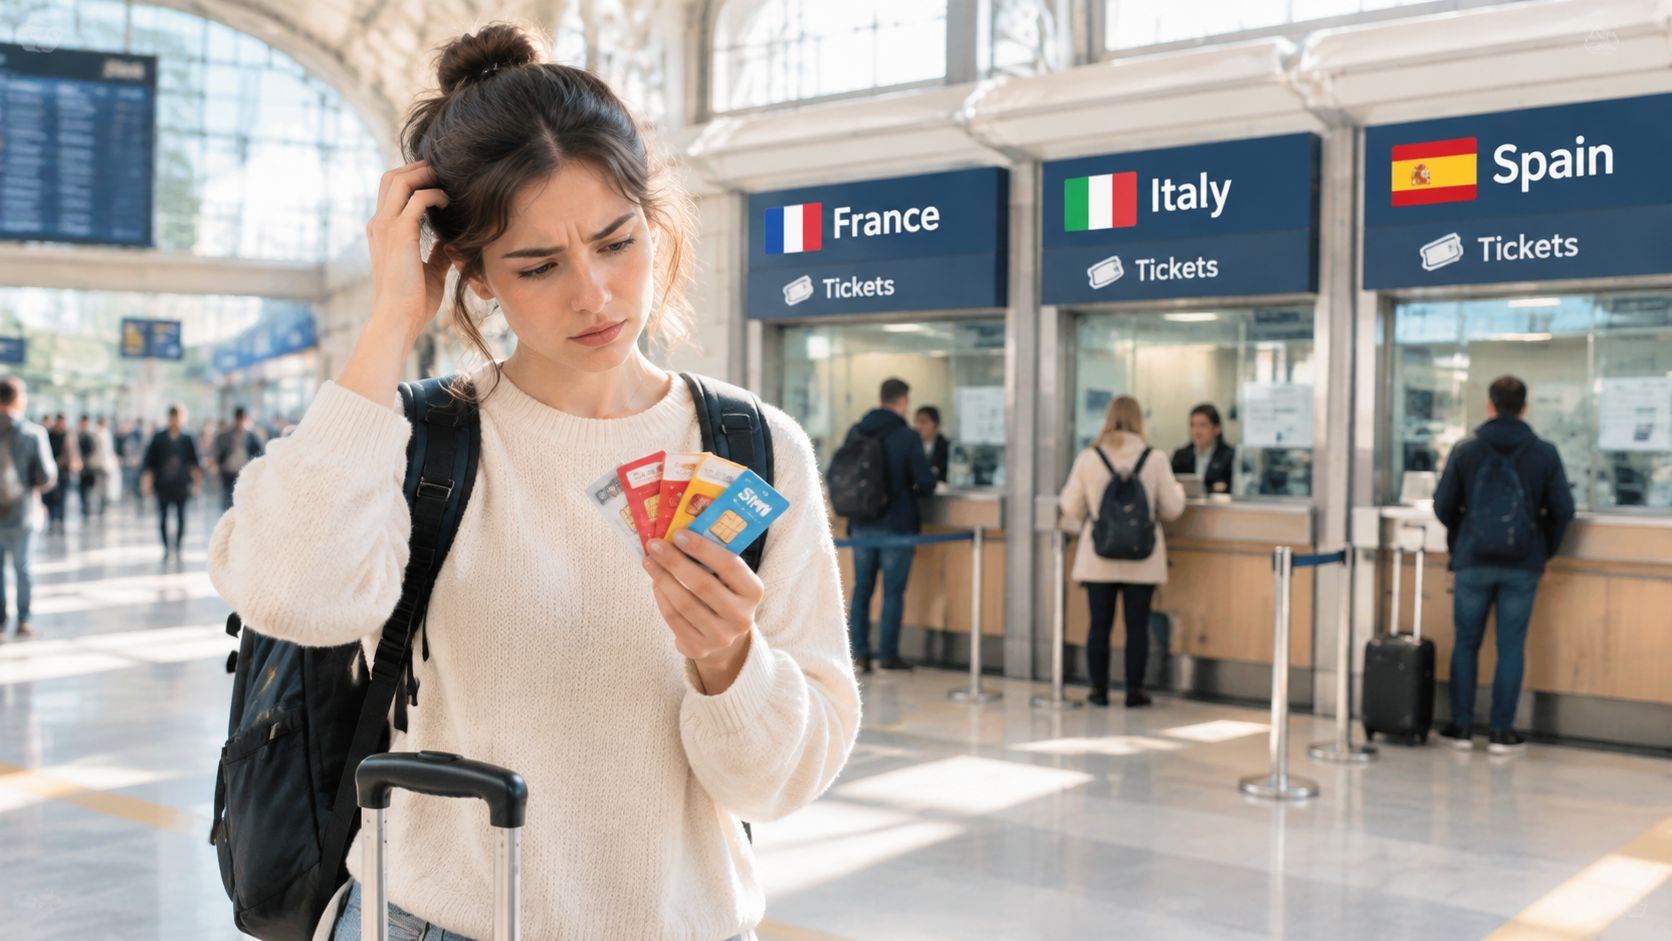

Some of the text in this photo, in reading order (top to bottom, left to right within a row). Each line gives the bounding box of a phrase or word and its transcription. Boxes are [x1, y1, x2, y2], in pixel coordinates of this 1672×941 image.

[1492, 135, 1614, 193] Spain
[1151, 171, 1232, 219] Italy
[833, 205, 940, 241] France
[1477, 231, 1579, 263] Tickets
[1135, 253, 1219, 282] Tickets
[822, 274, 895, 300] Tickets
